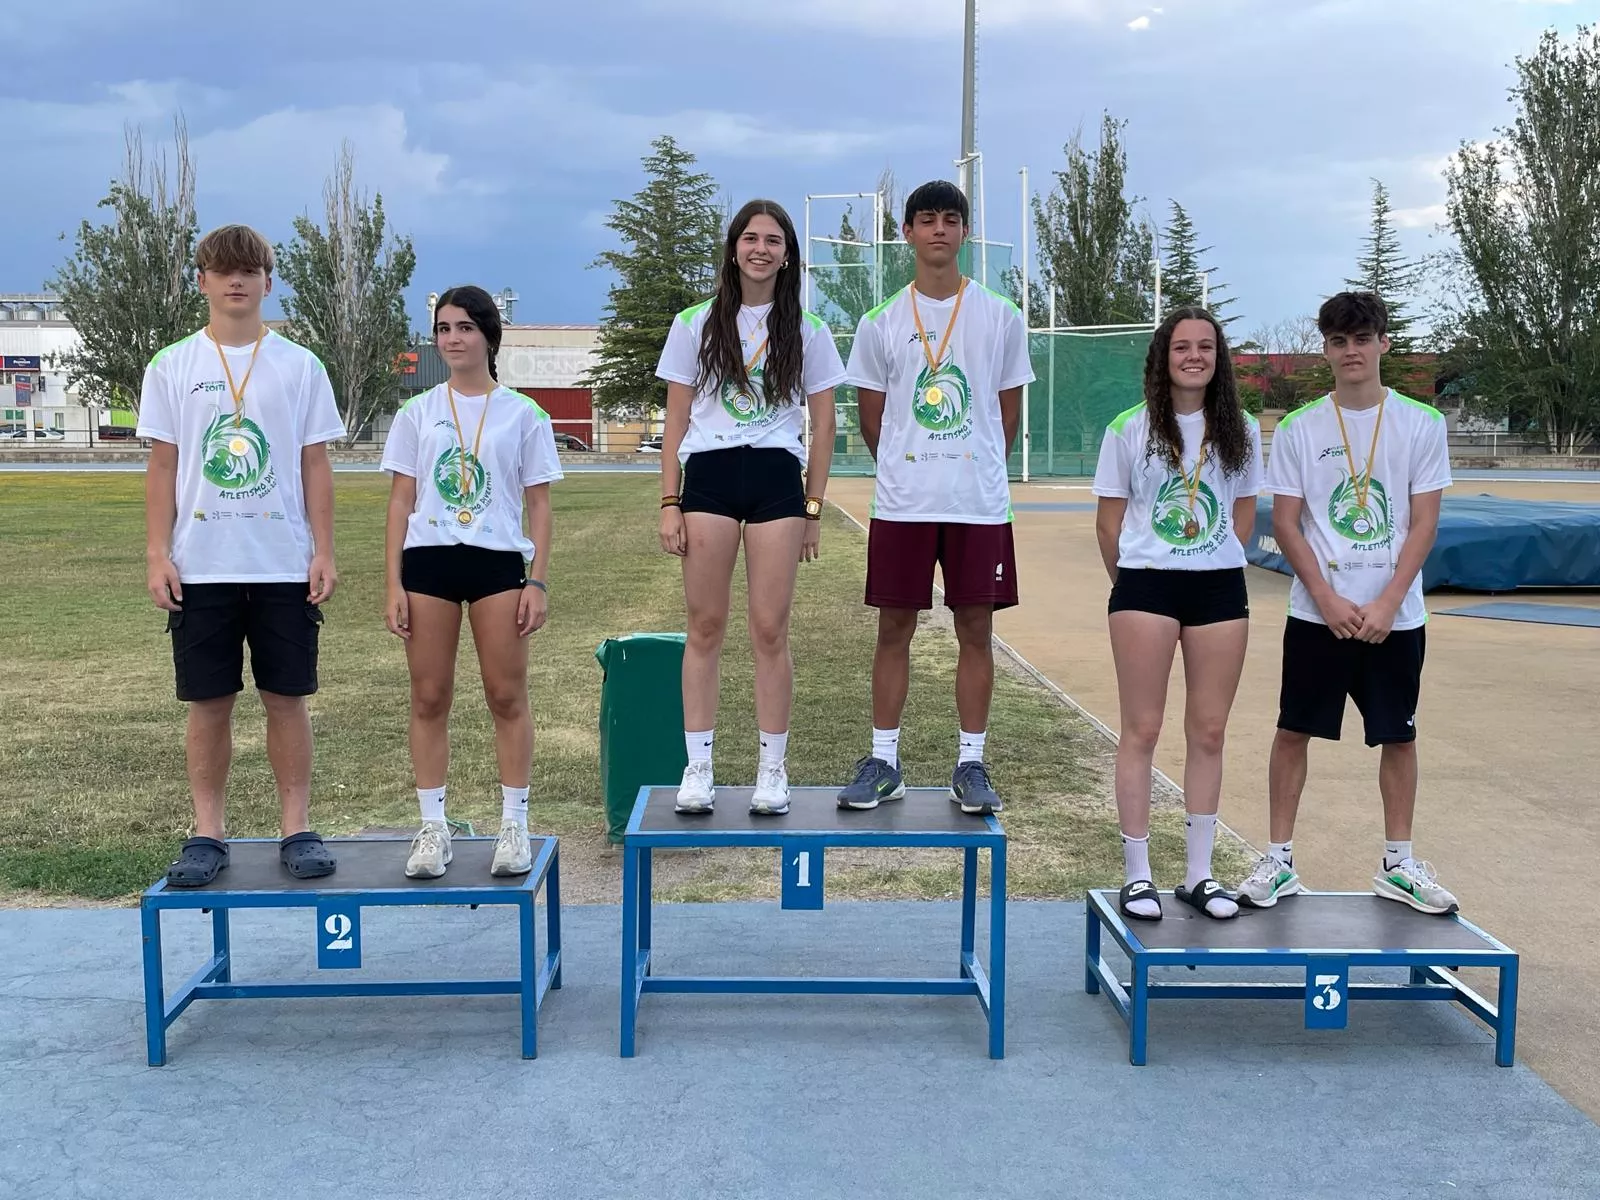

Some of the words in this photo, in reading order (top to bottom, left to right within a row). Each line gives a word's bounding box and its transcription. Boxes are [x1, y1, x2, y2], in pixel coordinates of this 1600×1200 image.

[928, 425, 968, 440] ATLETISMO
[219, 483, 266, 499] ATLETISMO
[1170, 541, 1214, 556] ATLETISMO
[792, 851, 811, 887] 1
[325, 914, 353, 949] 2
[1313, 975, 1341, 1010] 3
